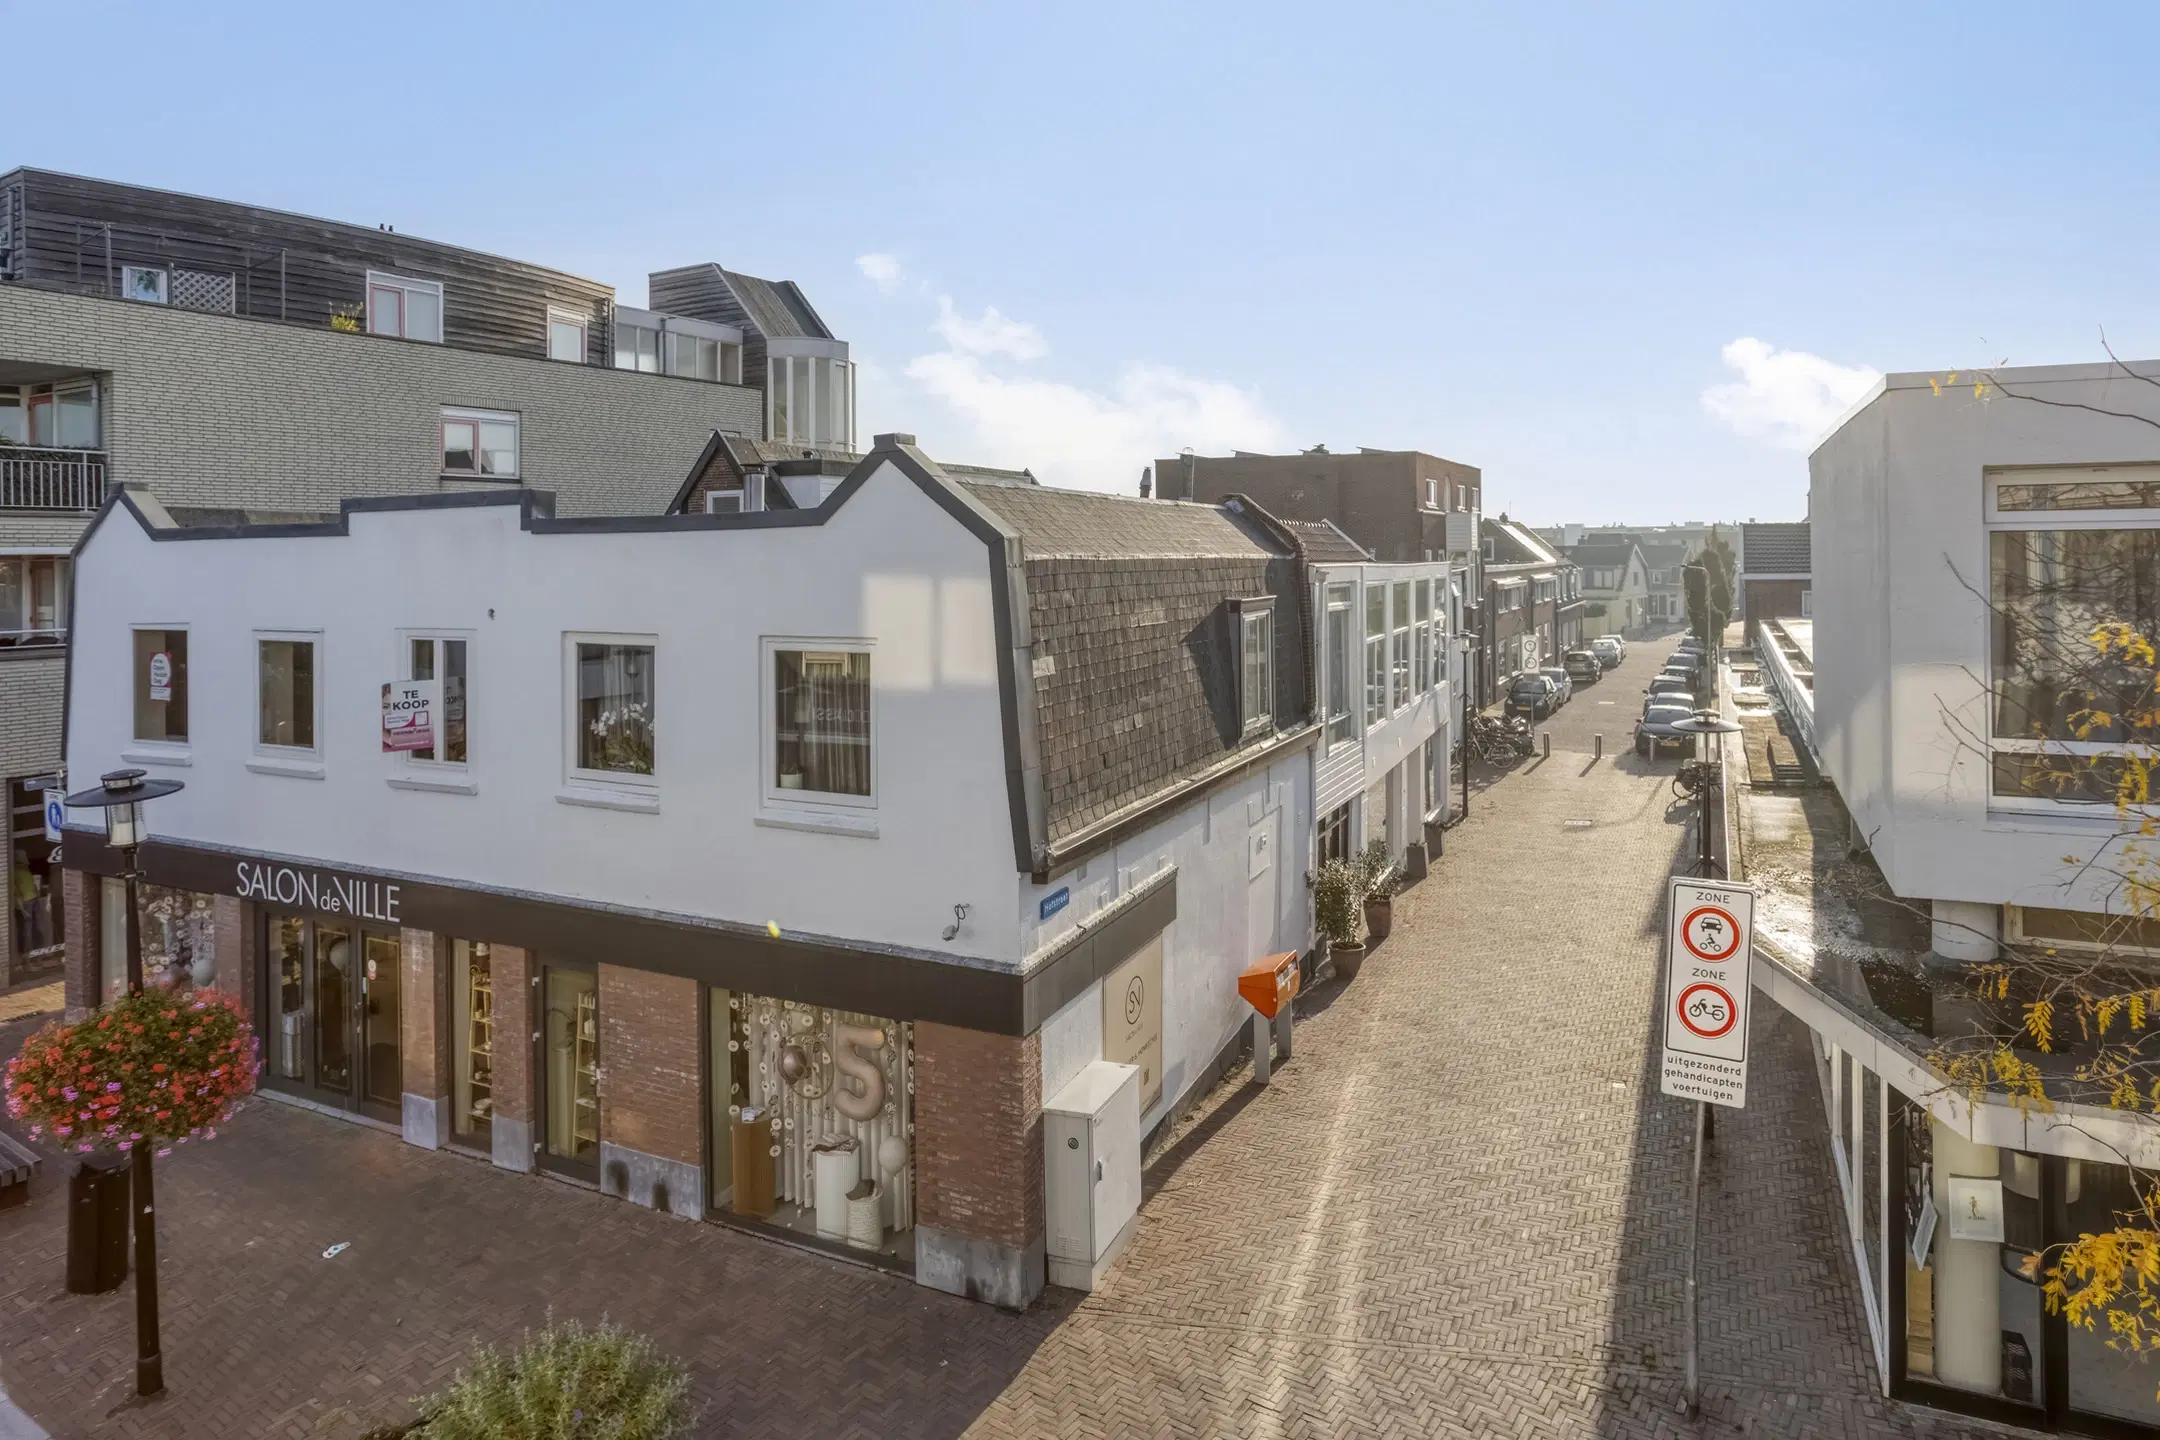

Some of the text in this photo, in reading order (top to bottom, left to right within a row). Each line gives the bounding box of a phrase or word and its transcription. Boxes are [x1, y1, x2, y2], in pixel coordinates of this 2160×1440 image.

[402, 689, 419, 700] TE
[392, 699, 430, 711] KOOP
[236, 862, 400, 923] SALON de VILLE
[1696, 891, 1731, 904] ZONE
[1692, 967, 1727, 981] ZONE
[1667, 1056, 1742, 1077] uitgezonderd
[1664, 1068, 1743, 1090] gehandicapten
[1672, 1082, 1733, 1101] voertuigen
